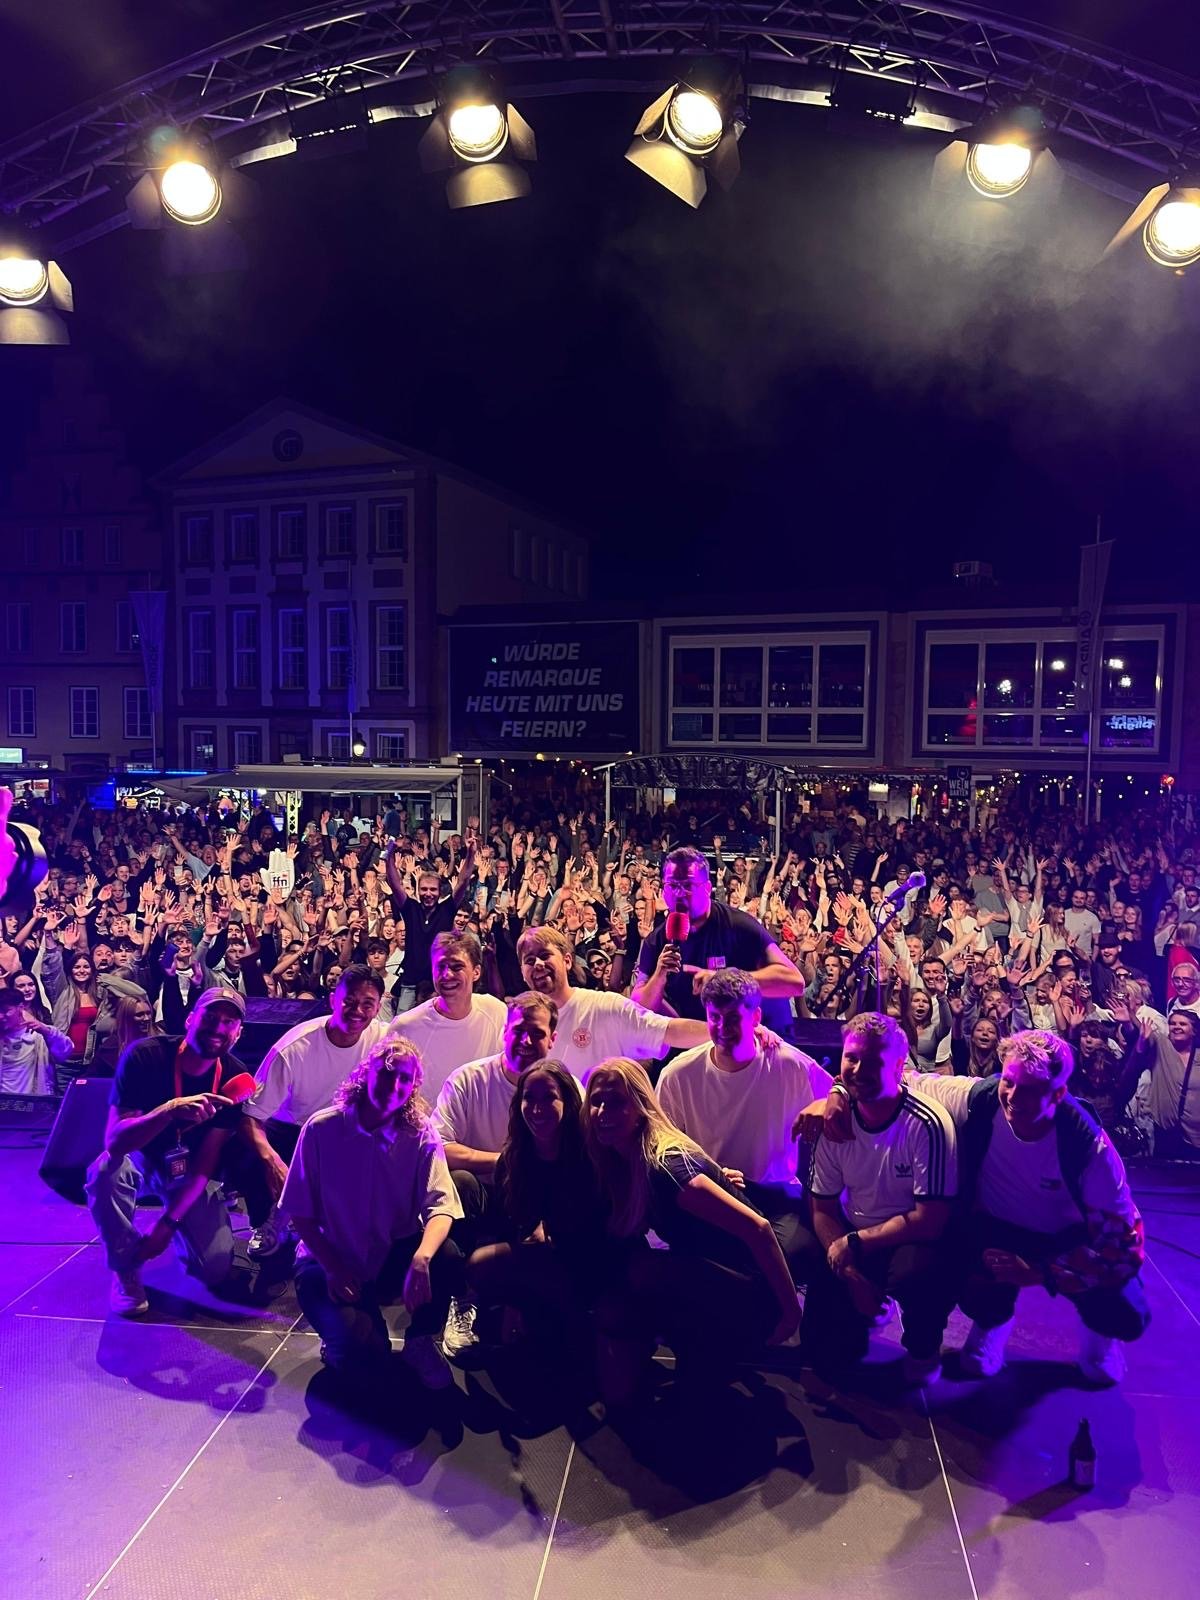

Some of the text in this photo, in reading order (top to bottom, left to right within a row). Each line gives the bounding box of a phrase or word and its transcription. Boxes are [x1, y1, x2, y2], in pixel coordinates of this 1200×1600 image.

[504, 641, 581, 662] WÜRDE
[484, 668, 602, 687] REMARQUE
[465, 693, 624, 712] HEUTE MIT UNS
[500, 720, 587, 738] FEIERN?
[948, 779, 969, 789] WEIN
[272, 876, 287, 887] ffn
